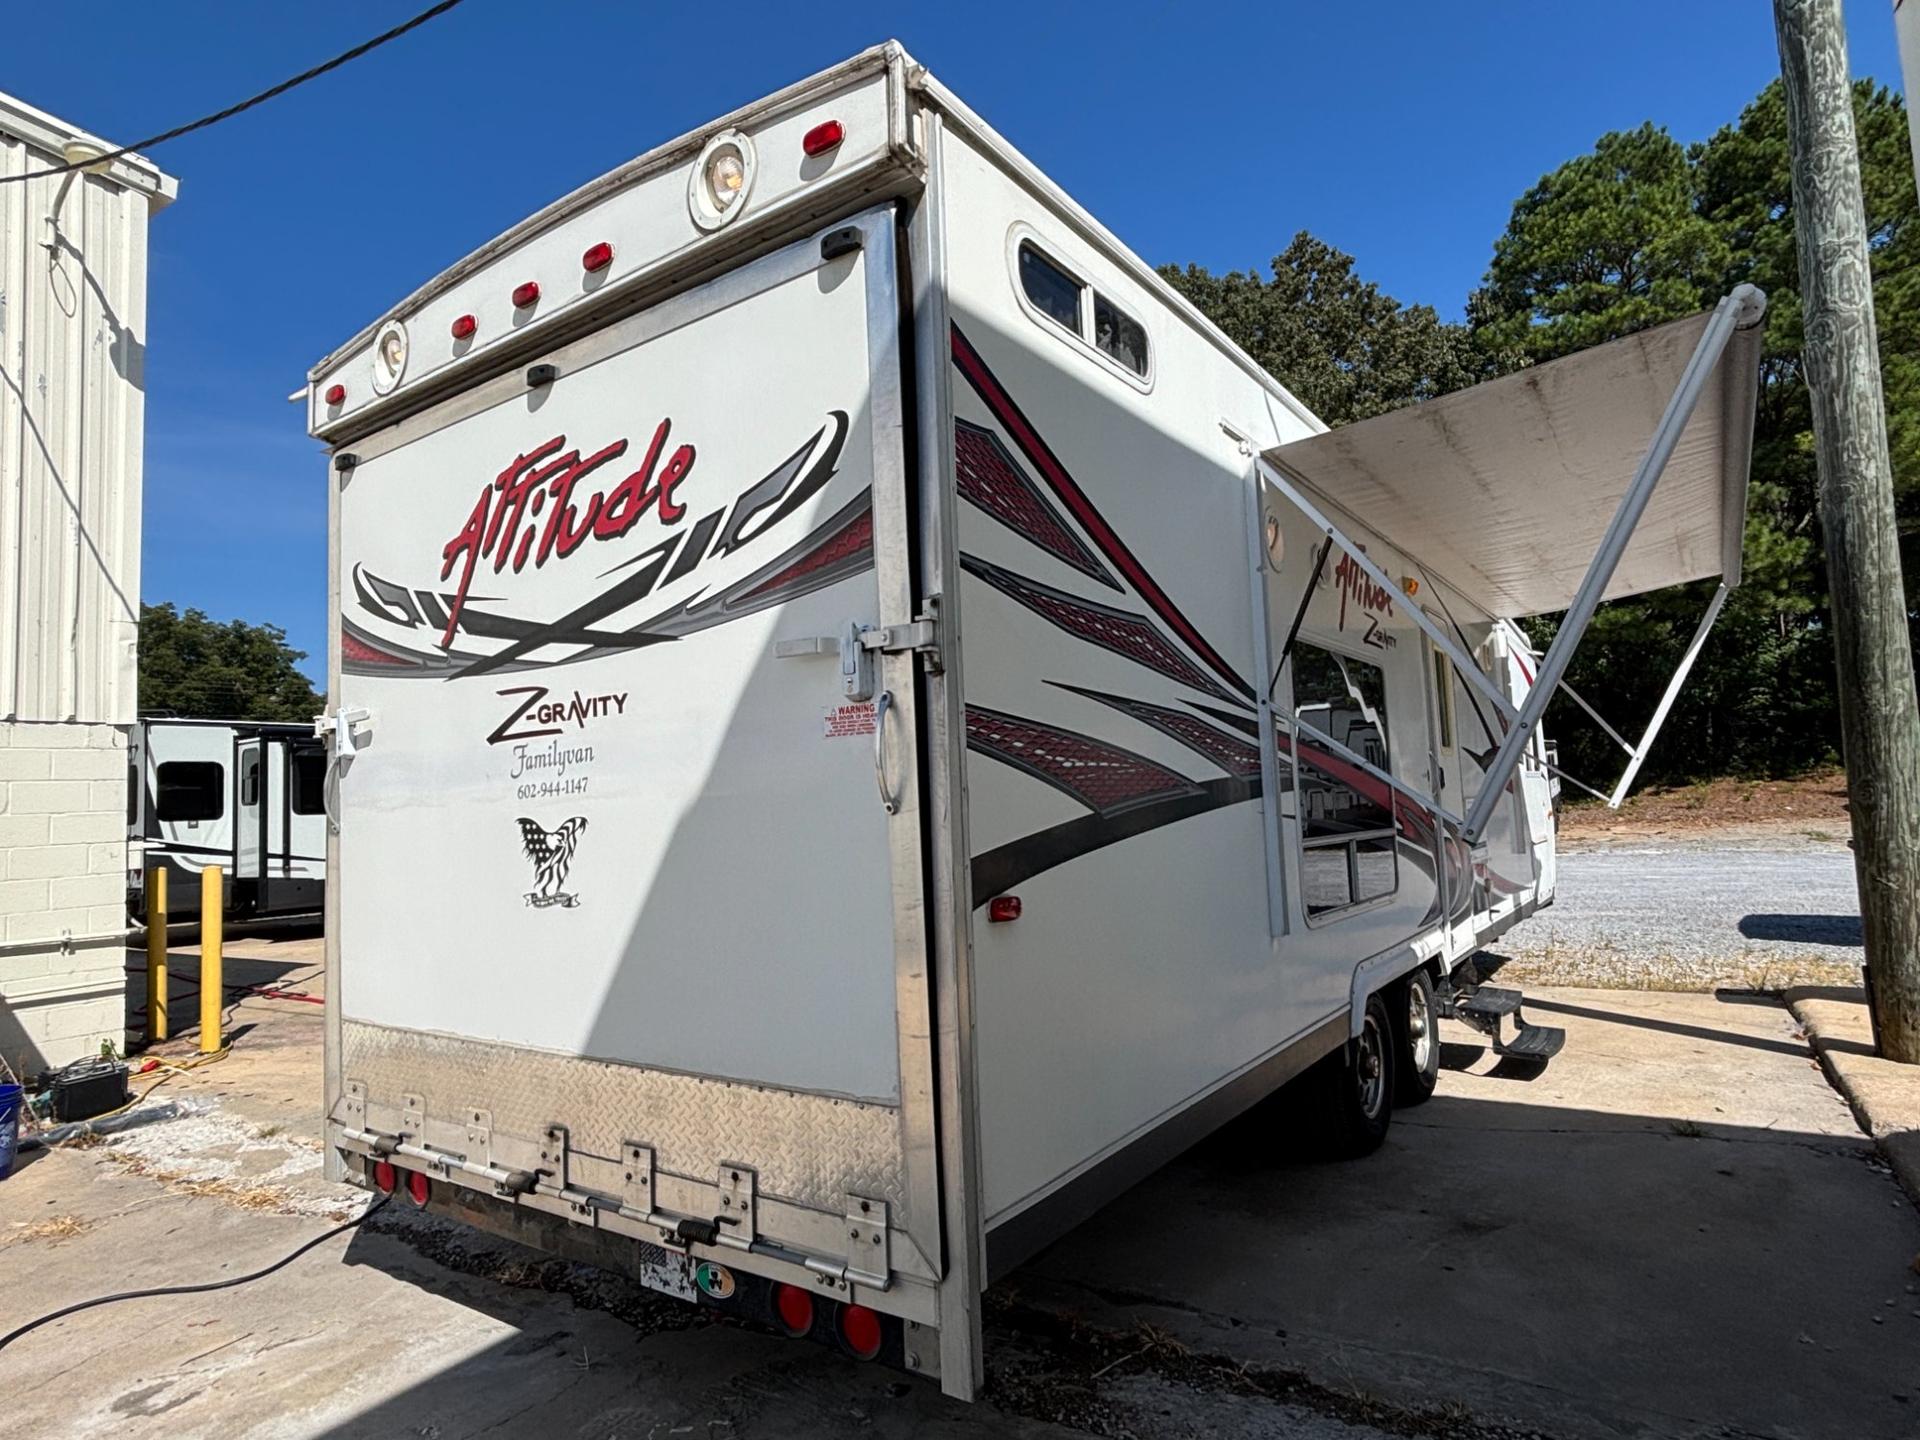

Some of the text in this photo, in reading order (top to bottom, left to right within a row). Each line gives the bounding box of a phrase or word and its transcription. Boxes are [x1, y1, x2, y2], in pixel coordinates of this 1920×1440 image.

[486, 686, 628, 746] Z-GRAVITY
[838, 703, 875, 715] WARNING
[510, 739, 594, 779] Familyvan
[517, 776, 588, 799] 602-944-1147
